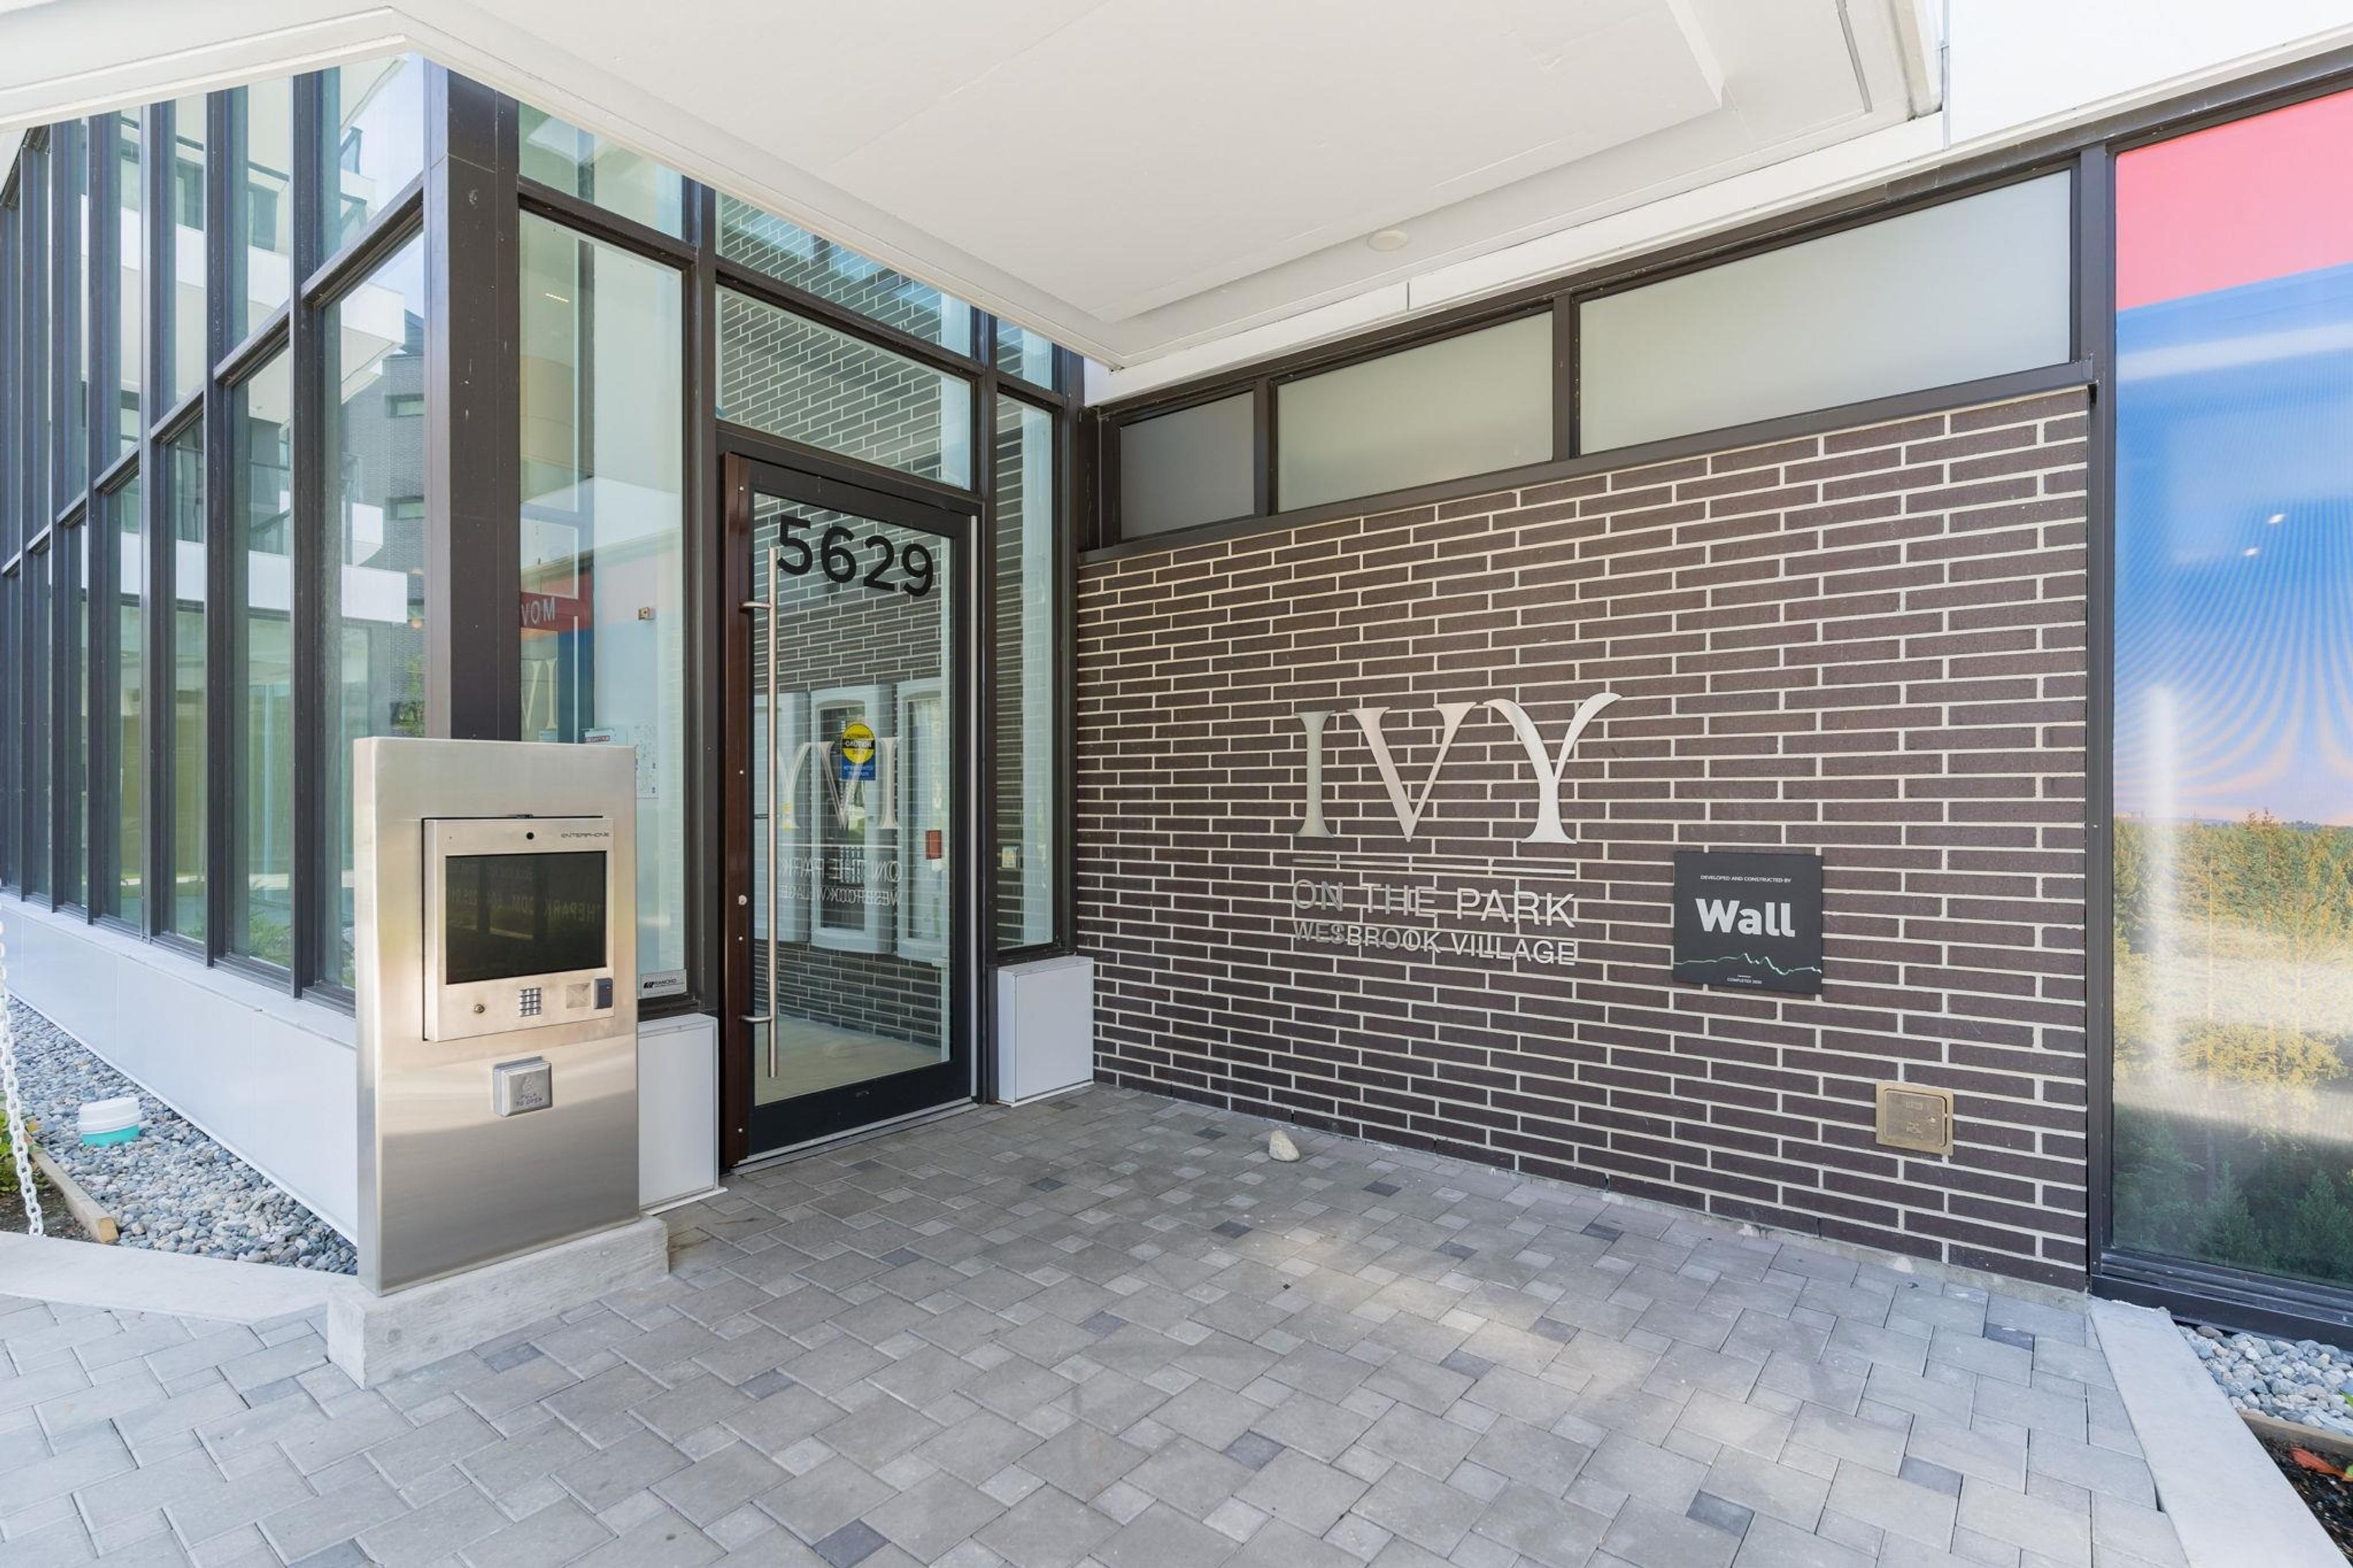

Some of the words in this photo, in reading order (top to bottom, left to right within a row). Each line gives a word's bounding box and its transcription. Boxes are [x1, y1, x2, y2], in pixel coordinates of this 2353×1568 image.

[778, 514, 933, 597] 5629
[1294, 692, 1623, 844] IVY
[1292, 879, 1344, 912] ON
[1360, 883, 1437, 917] THE
[1457, 888, 1576, 928] PARK
[1696, 898, 1796, 937] Wall
[1293, 920, 1441, 954] WESBROOK
[1451, 932, 1576, 966] VILLAGE
